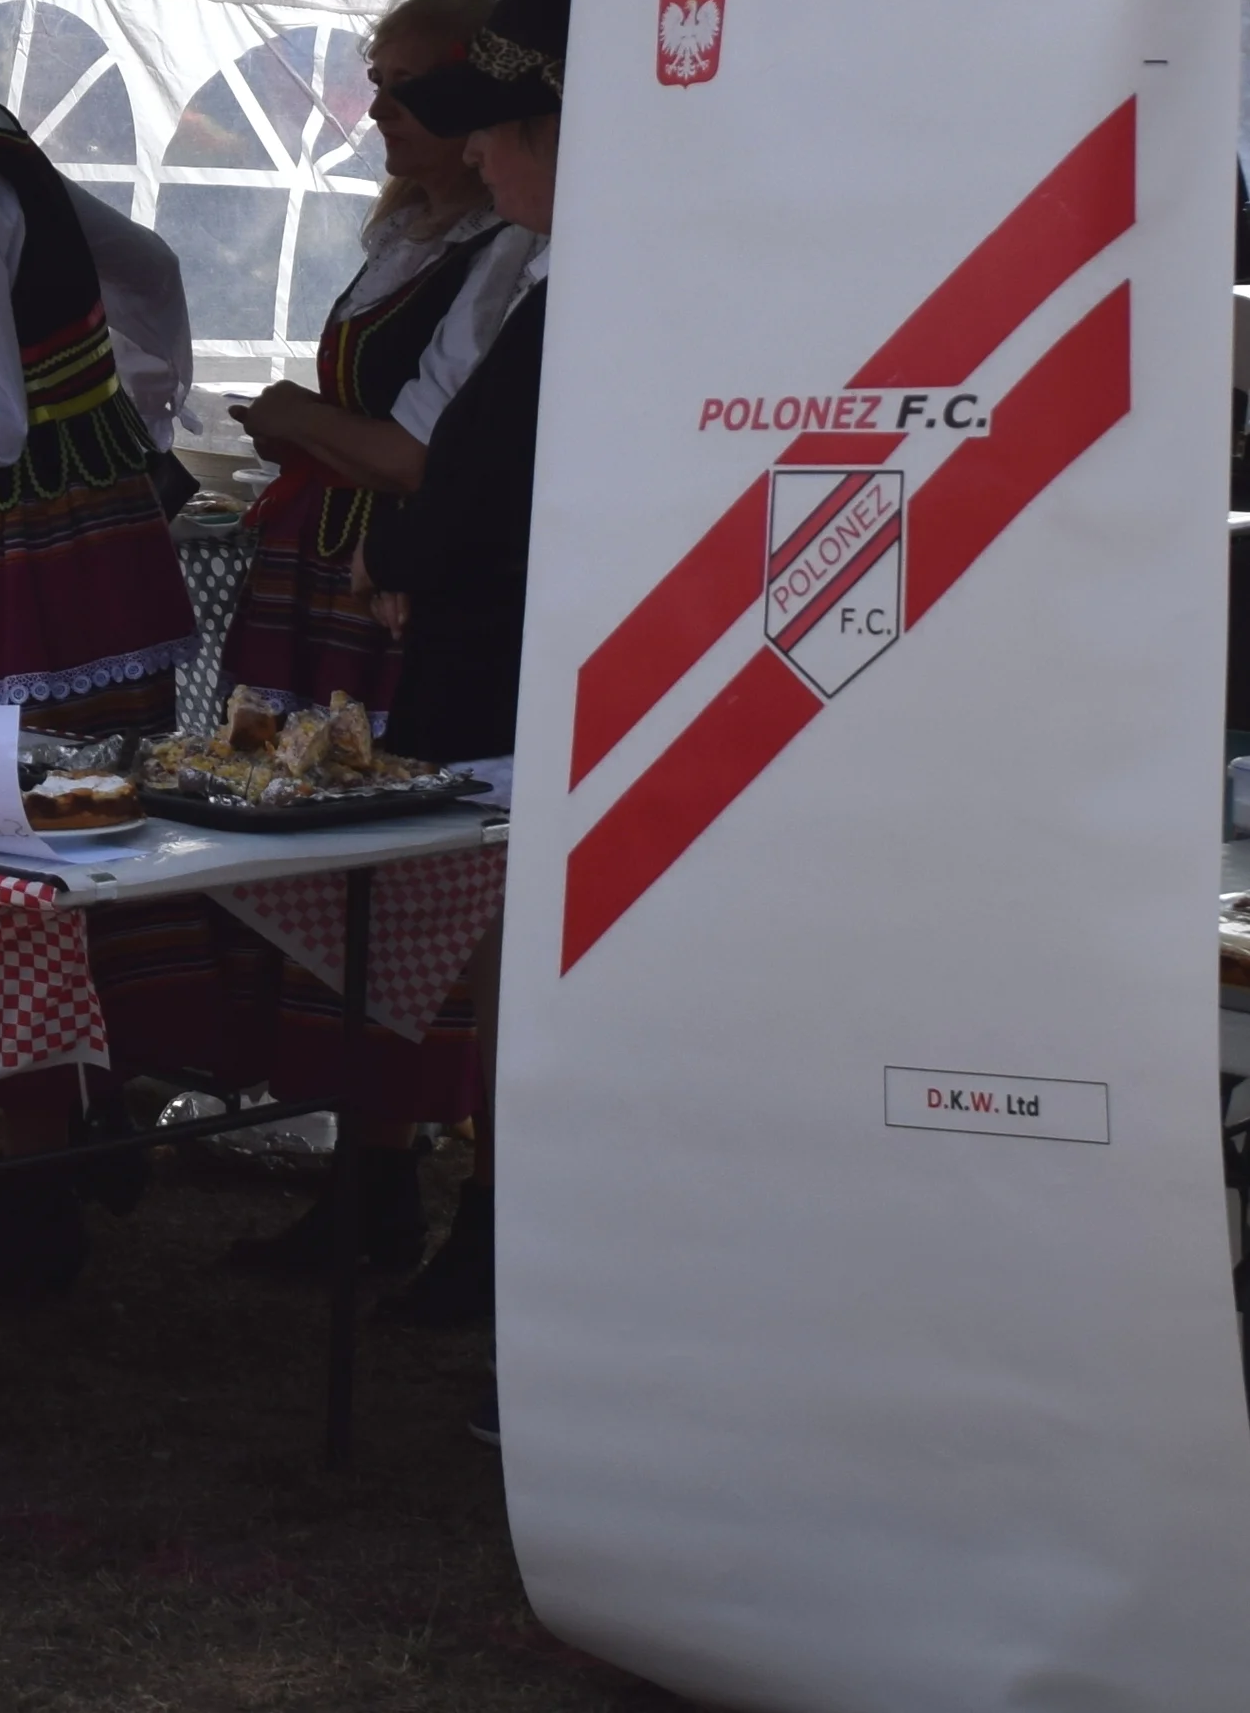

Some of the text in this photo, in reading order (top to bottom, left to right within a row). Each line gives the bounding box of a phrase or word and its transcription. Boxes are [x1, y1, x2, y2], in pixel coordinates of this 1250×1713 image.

[698, 393, 988, 432] POLONEZ F.C.
[772, 483, 893, 614] POLONEZ
[840, 607, 893, 636] F.C.
[1006, 1094, 1039, 1117] Ltd
